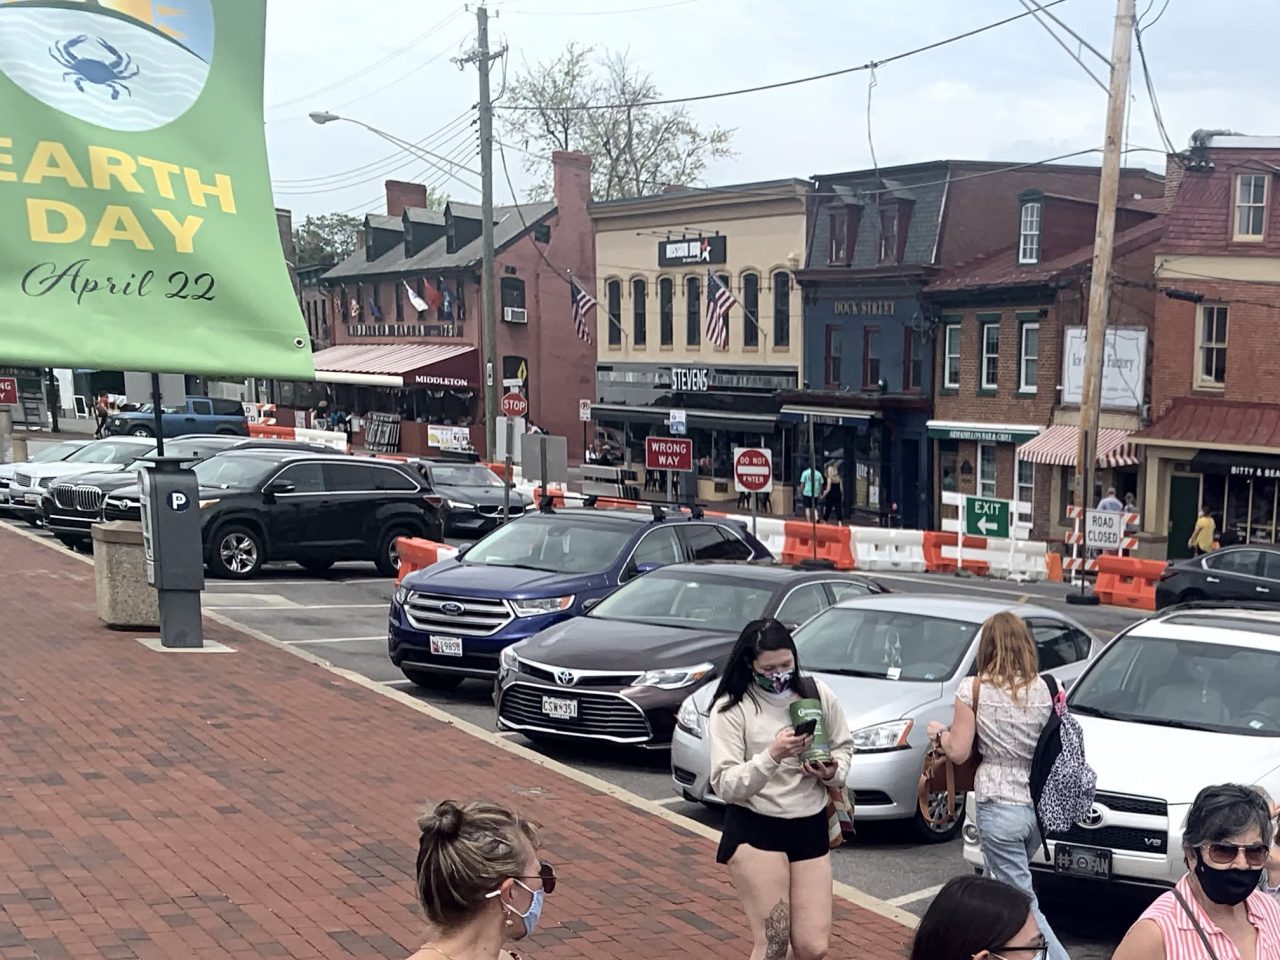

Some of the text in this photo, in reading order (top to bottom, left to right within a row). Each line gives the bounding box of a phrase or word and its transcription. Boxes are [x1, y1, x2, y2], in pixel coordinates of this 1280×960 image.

[0, 137, 237, 215] EARTH
[26, 197, 204, 254] DAY
[20, 258, 216, 305] April 22
[834, 301, 895, 316] DOCK STREET
[415, 375, 468, 387] MIDDLETON
[671, 368, 708, 391] STEVENS
[503, 400, 526, 411] STOP
[651, 442, 687, 454] WRONG
[658, 455, 680, 466] WAY
[740, 456, 766, 465] DO NOT
[1231, 466, 1254, 475] BITTY
[1256, 468, 1262, 476] &
[742, 475, 764, 483] ENTER
[974, 501, 1001, 515] EXIT
[1092, 515, 1114, 529] ROAD
[1087, 530, 1118, 544] CLOSED
[563, 703, 576, 715] 351
[1144, 838, 1161, 846] V6
[1088, 856, 1109, 875] FAN
